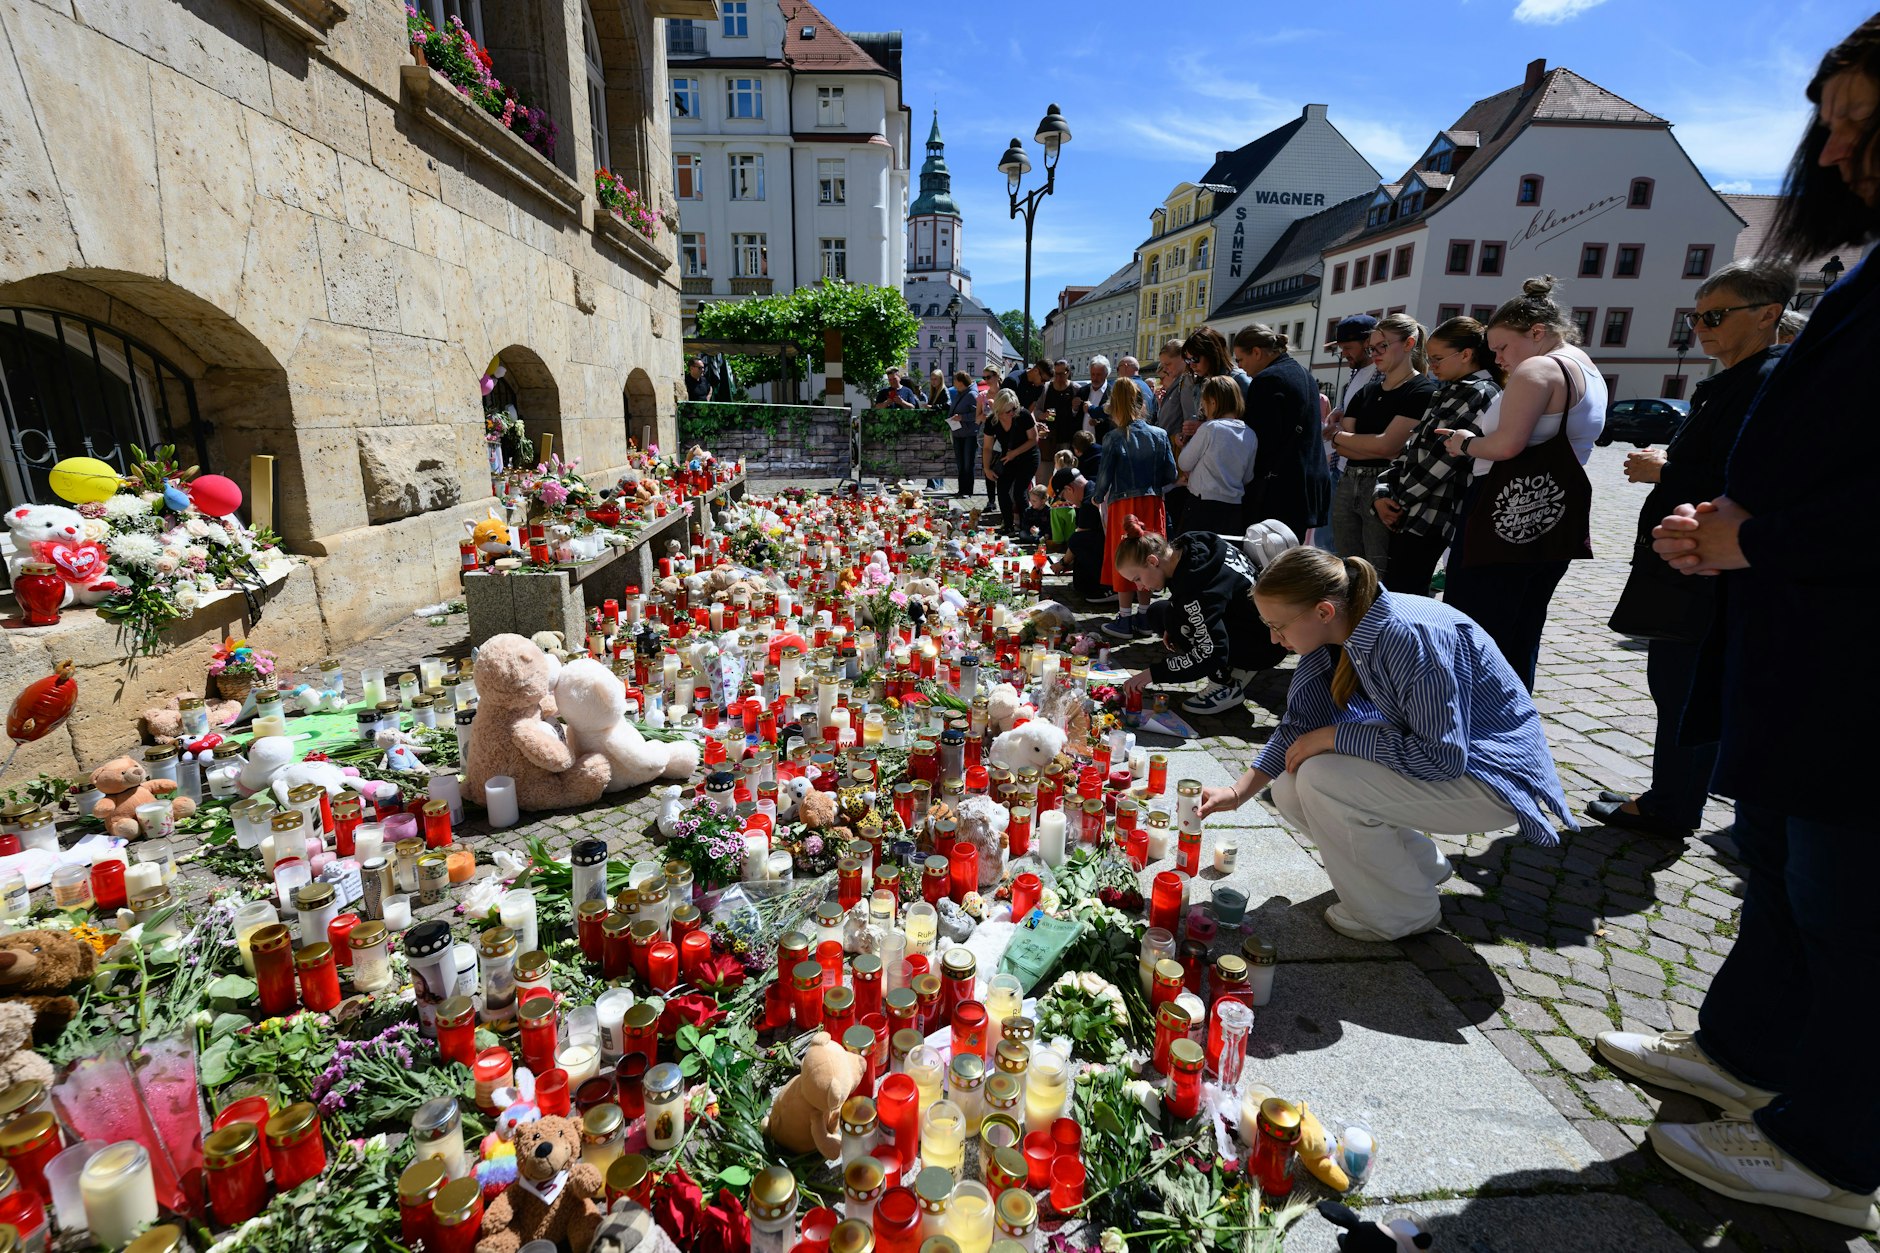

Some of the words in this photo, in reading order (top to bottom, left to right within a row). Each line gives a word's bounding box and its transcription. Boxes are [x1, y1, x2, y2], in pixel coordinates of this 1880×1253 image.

[1256, 191, 1325, 206] WAGNER
[1230, 207, 1247, 277] SAMEN
[1507, 490, 1536, 508] Get
[1534, 486, 1550, 503] up
[1500, 506, 1552, 528] Change
[1737, 1158, 1777, 1168] ESPRI
